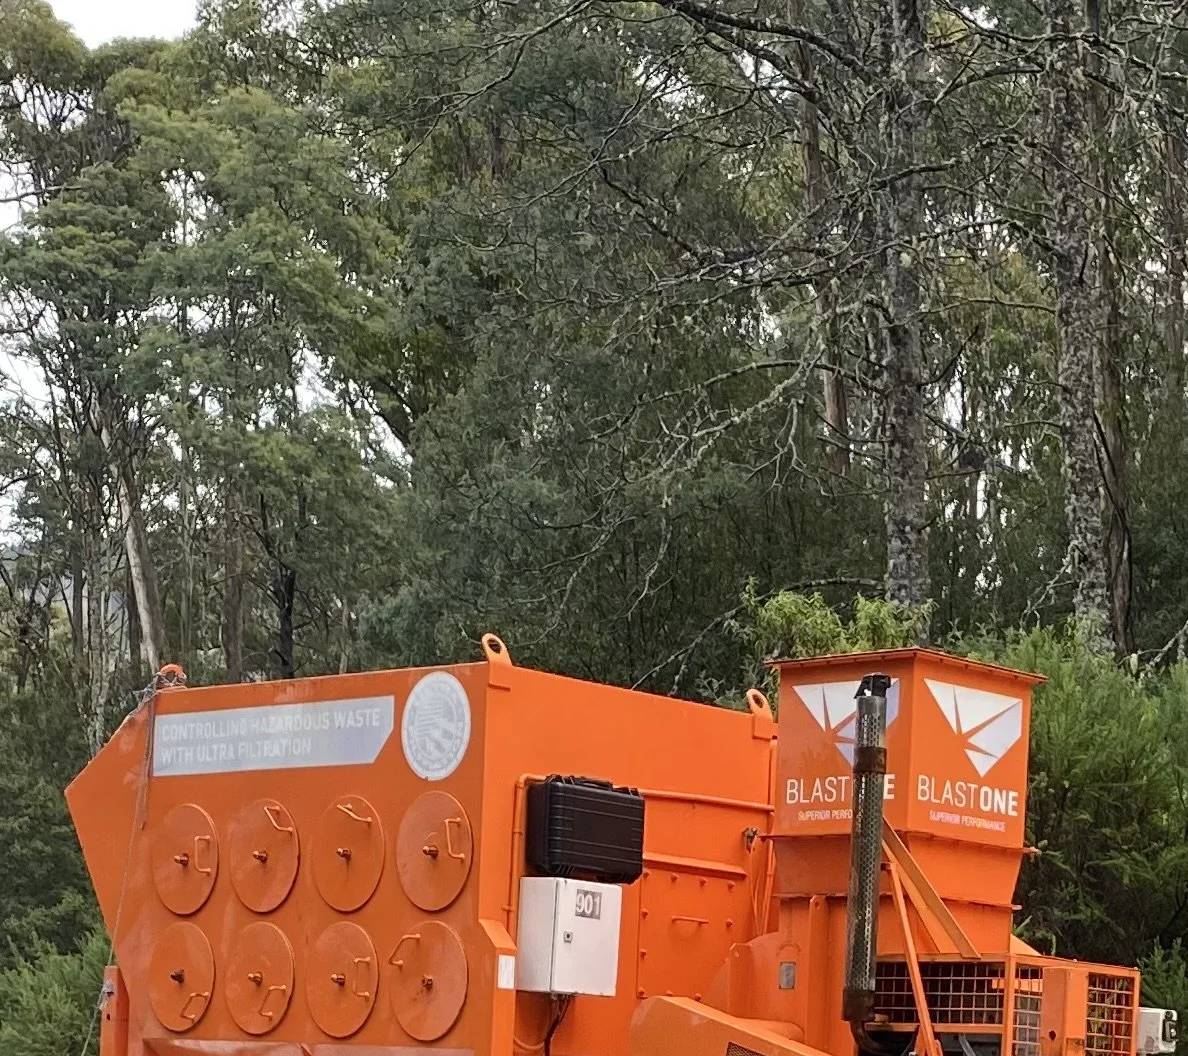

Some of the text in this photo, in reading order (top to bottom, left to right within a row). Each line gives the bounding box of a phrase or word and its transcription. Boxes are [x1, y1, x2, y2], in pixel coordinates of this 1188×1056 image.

[161, 708, 381, 742] CONTROLLING HAZARDOUS WASTE
[161, 738, 312, 765] WITH ULTRA FILTRATION
[917, 774, 1019, 817] BLASTONE
[798, 809, 831, 821] SUPERIOR
[929, 810, 1006, 833] SUPERIOR PERFORMANCE
[576, 892, 602, 917] 901
